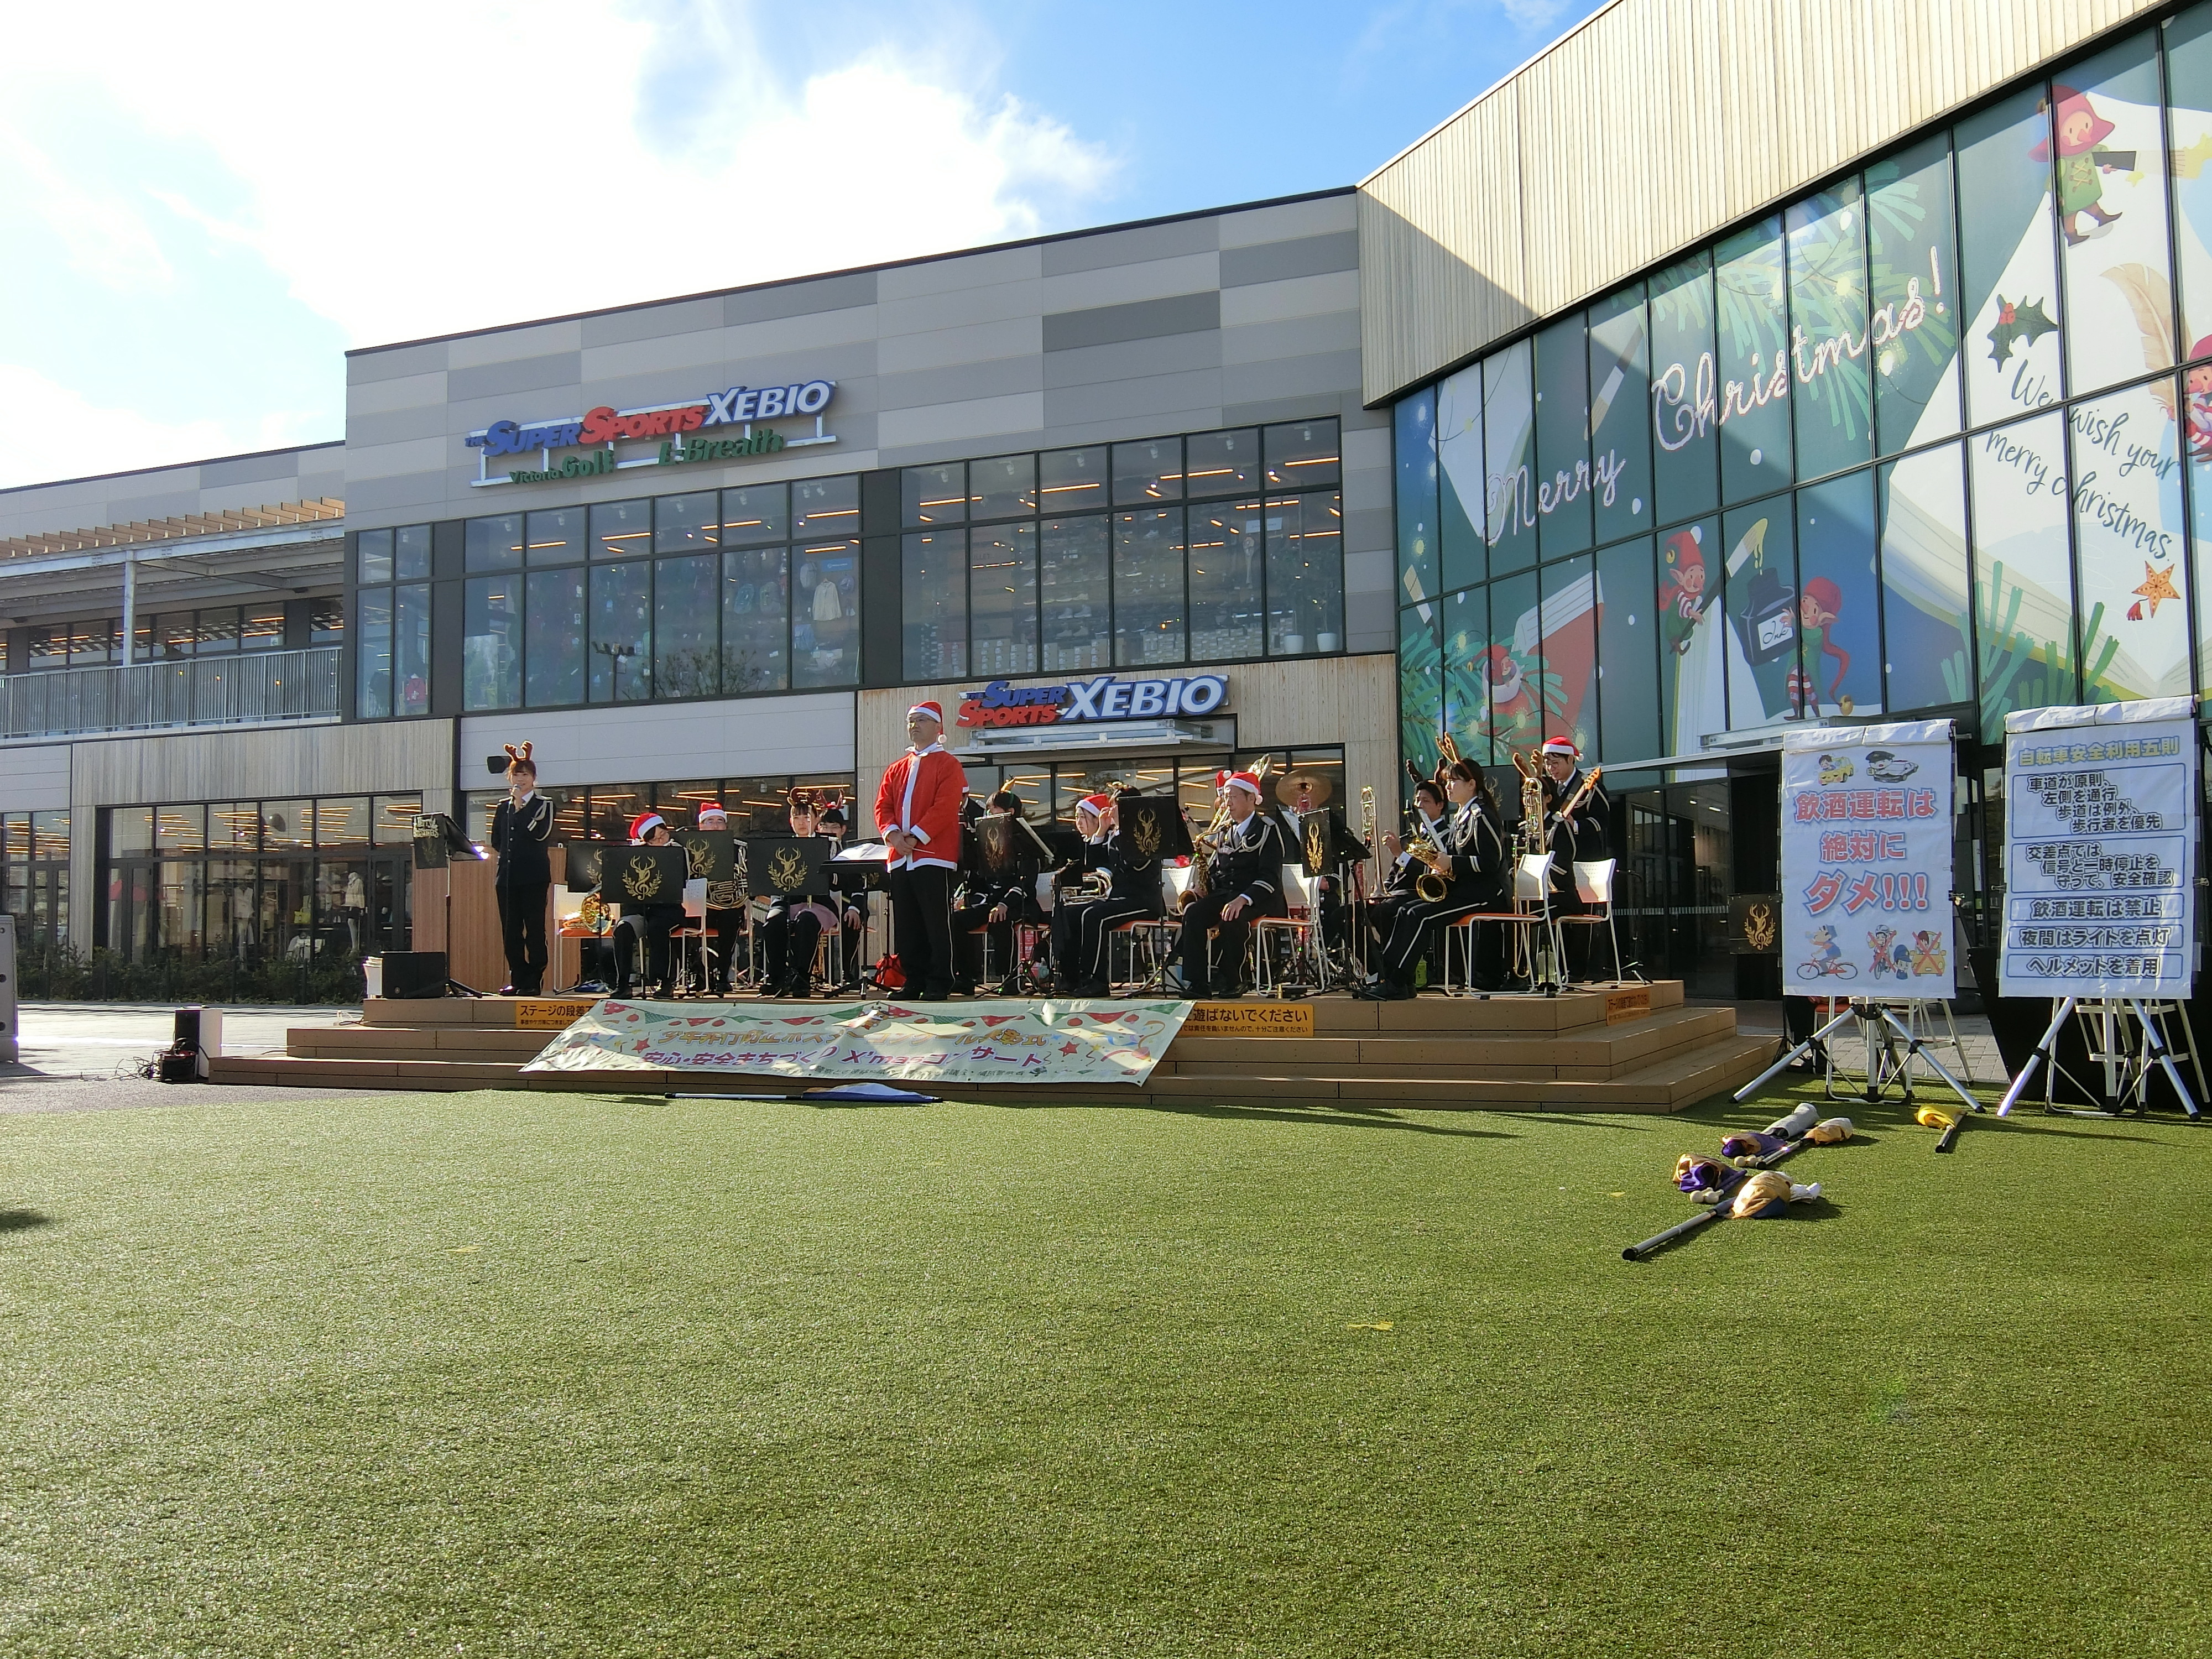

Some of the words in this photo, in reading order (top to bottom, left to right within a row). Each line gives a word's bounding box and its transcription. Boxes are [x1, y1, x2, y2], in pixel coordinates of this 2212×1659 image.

[1486, 448, 1626, 546] Merry
[1651, 245, 1947, 451] Christmas!
[465, 435, 484, 448] THE
[482, 421, 581, 456] SUPER
[579, 406, 708, 444] SPORTS
[704, 380, 835, 426] XEBIO
[2011, 359, 2055, 408] We
[2069, 406, 2129, 456] wish
[2119, 443, 2180, 480] your
[509, 467, 562, 484] Victoria
[562, 450, 614, 478] Golf
[658, 429, 783, 466] L-Breath
[1985, 431, 2048, 495] merry
[966, 691, 985, 700] THE
[982, 680, 1067, 708] SUPER
[1061, 675, 1227, 721] XEBIO
[956, 700, 1060, 727] SPORTS
[2019, 737, 2180, 767] 自転車安全利用五則
[2029, 772, 2110, 791] 車道が原則、
[1795, 789, 1936, 822] 飲酒運転は
[2043, 787, 2117, 805] 左側を通行
[2057, 801, 2138, 820] 歩道は例外、
[2072, 815, 2161, 833] 歩行者を優先
[1820, 831, 1906, 863] 絶対に
[2027, 844, 2101, 860] 交差点では
[2043, 855, 2158, 874] 信号と一時停止を
[2032, 899, 2161, 919] 飲酒運転は禁止
[2021, 927, 2169, 948] 夜間はライトを点灯
[2028, 956, 2160, 976] ヘルメットを着用
